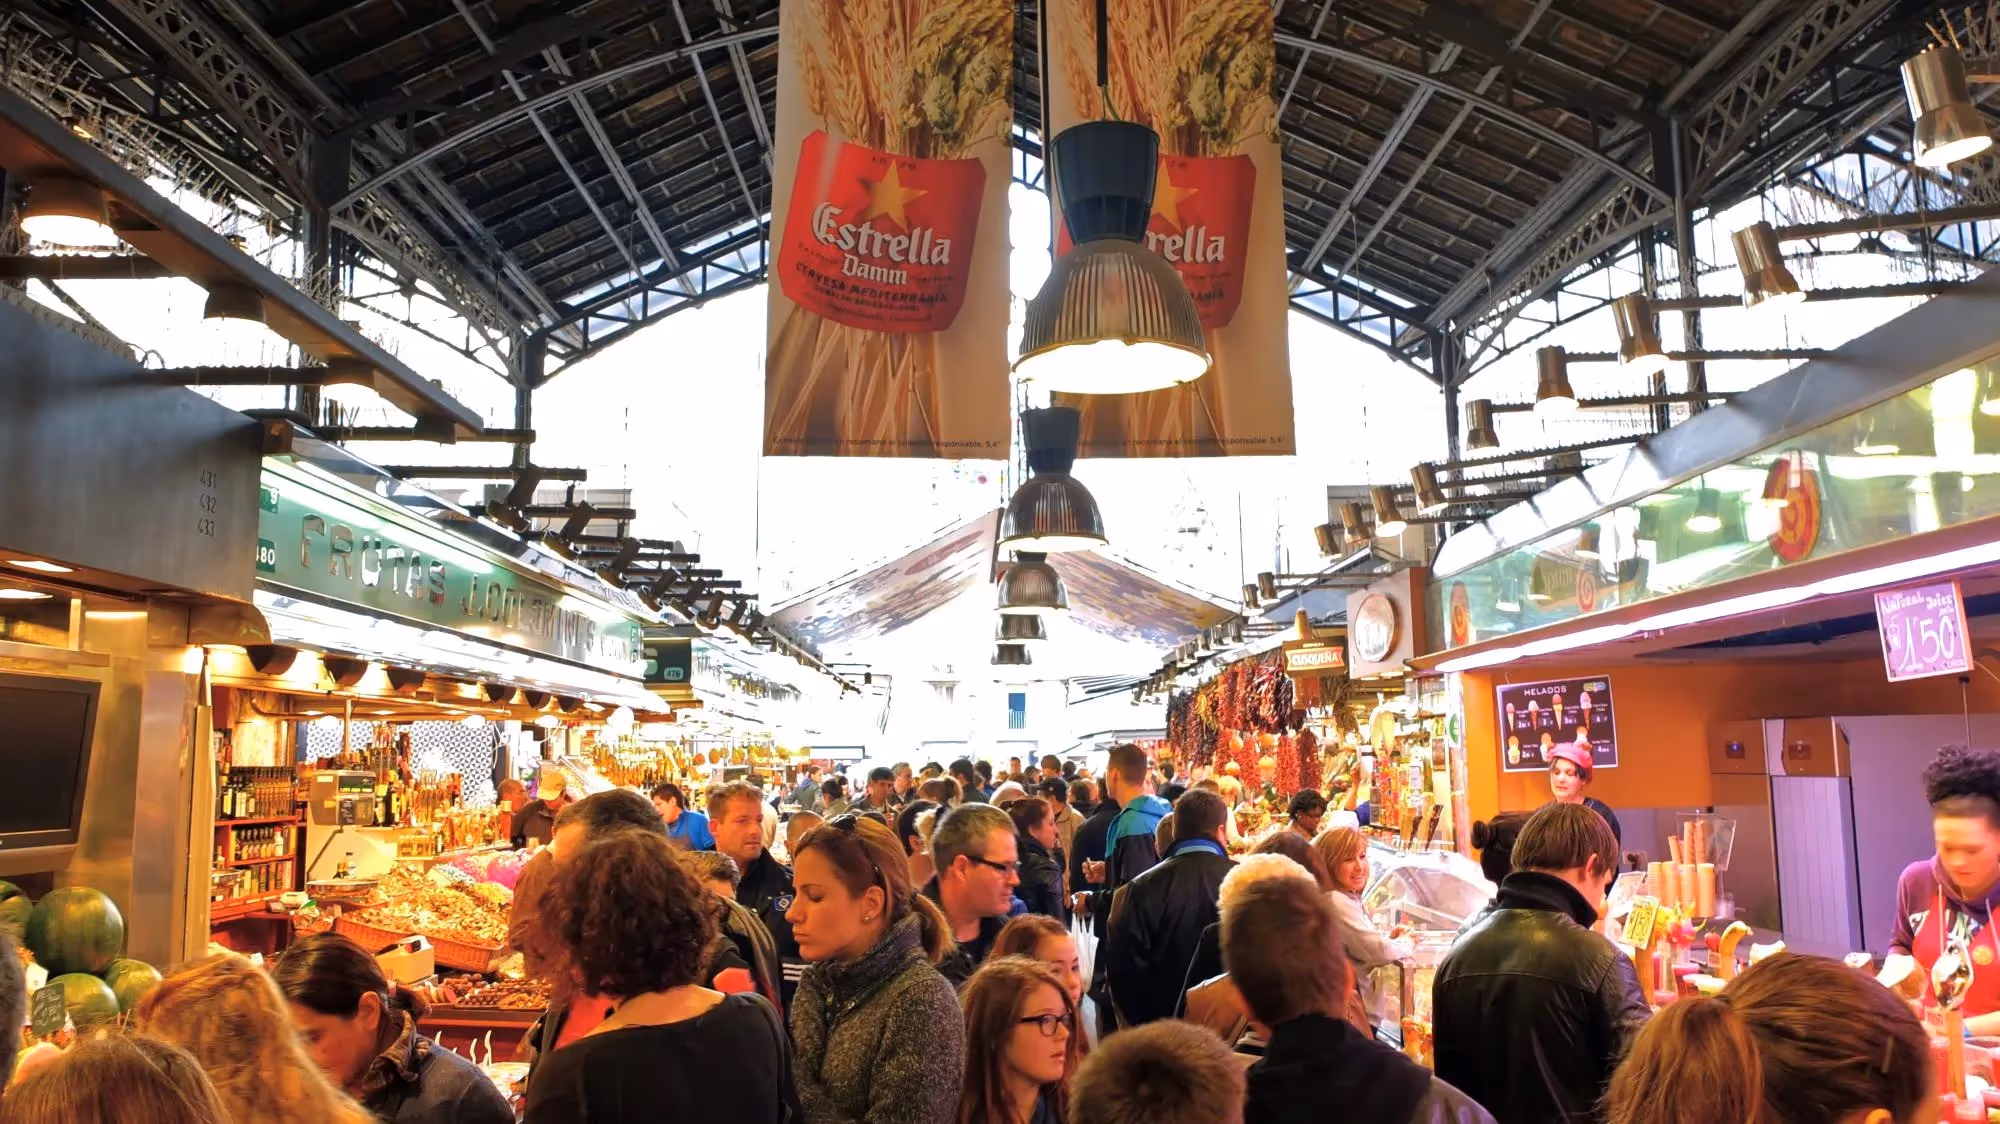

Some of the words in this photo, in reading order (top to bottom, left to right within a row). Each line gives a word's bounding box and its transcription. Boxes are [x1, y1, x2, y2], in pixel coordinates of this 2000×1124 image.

[812, 201, 951, 265] Estrella
[1146, 225, 1226, 264] rella
[841, 252, 908, 285] Damm
[200, 468, 217, 489] 431
[199, 493, 217, 514] 432
[198, 517, 216, 537] 433
[302, 513, 446, 607] FRUTAS
[1523, 685, 1567, 696] HELADOS
